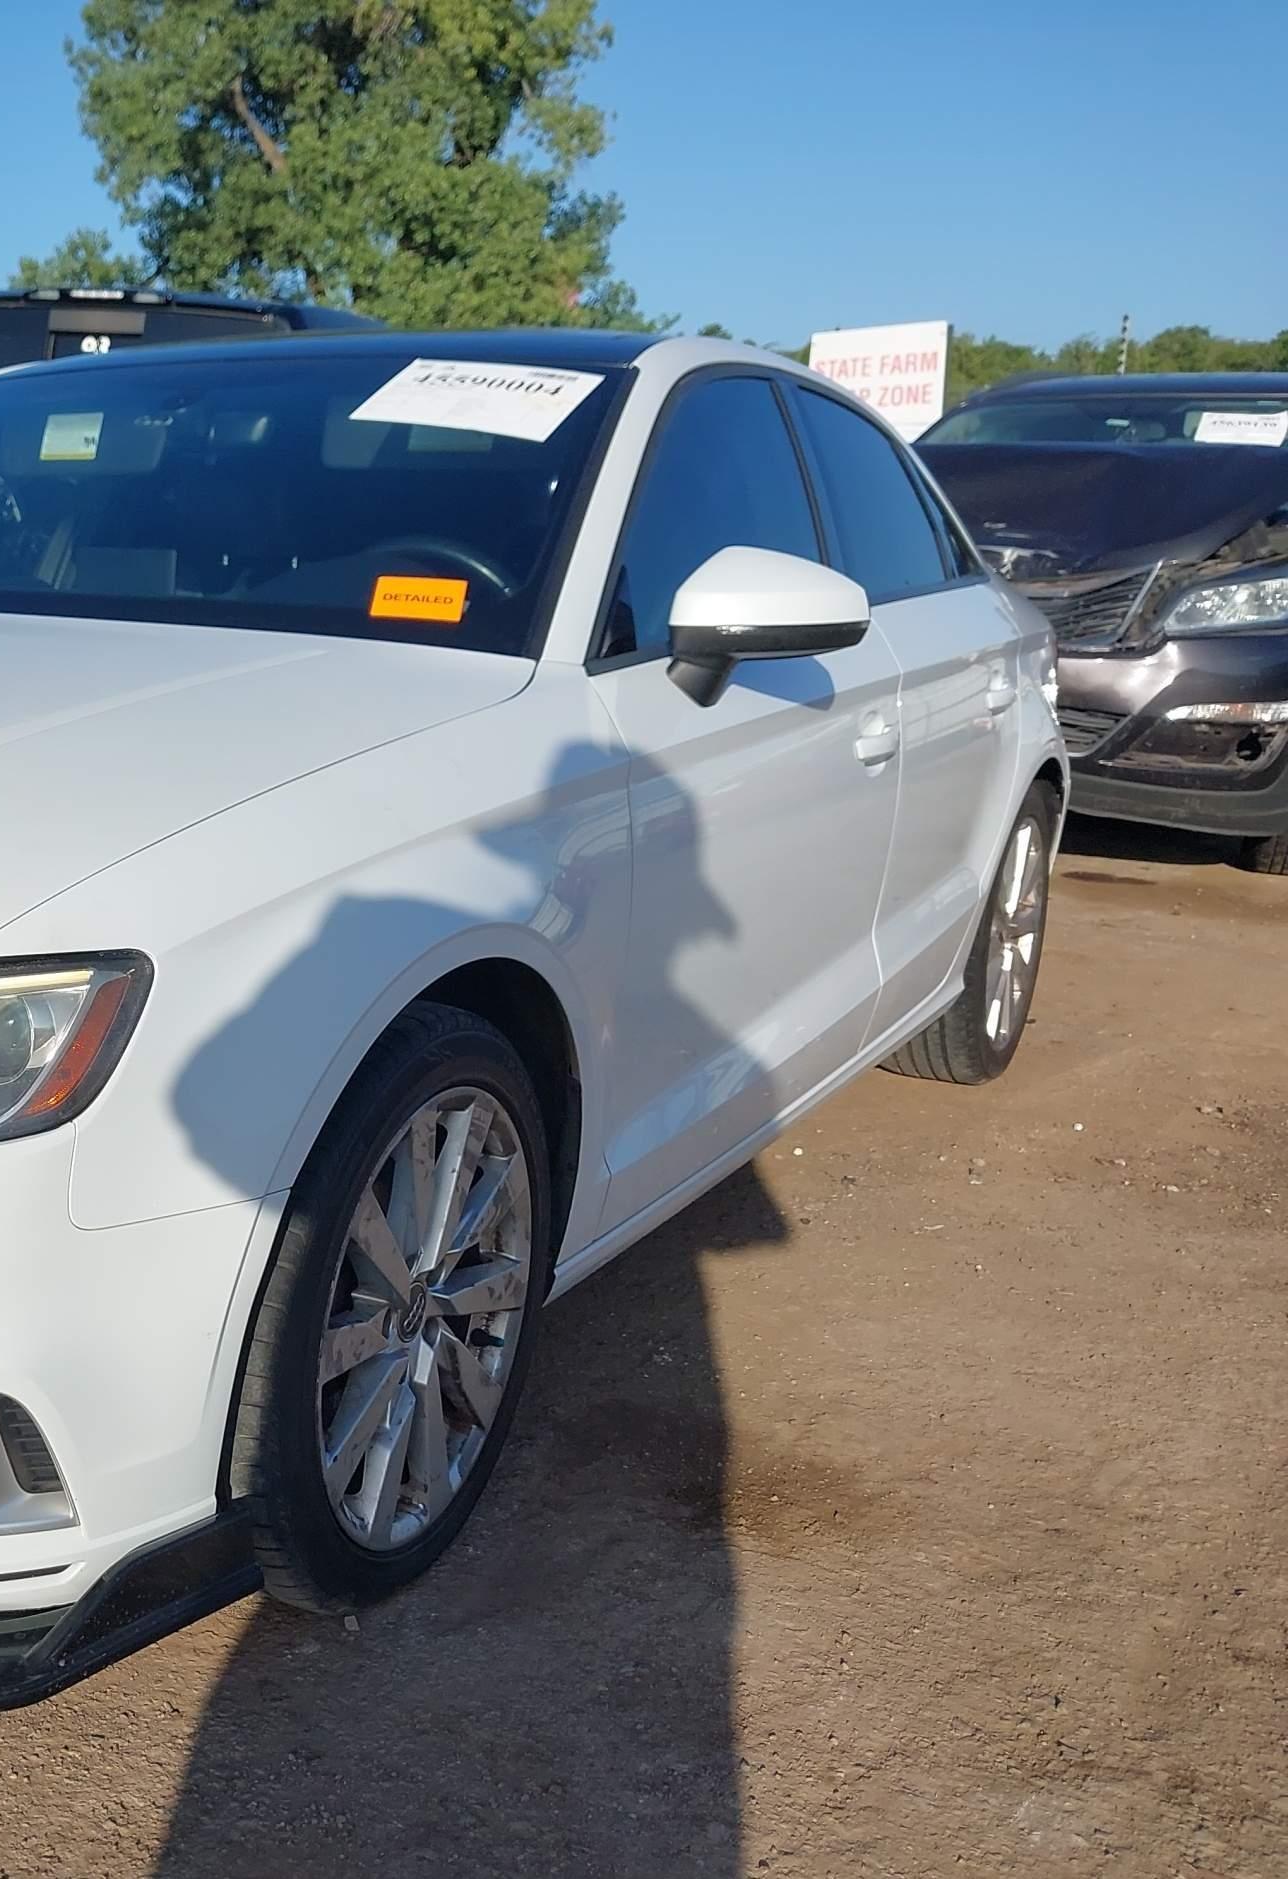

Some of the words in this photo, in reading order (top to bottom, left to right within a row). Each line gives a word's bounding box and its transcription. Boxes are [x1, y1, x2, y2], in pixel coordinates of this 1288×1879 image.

[814, 356, 873, 380] STATE
[879, 351, 939, 376] FARM
[877, 382, 934, 408] ZONE
[382, 592, 454, 605] DETAILED
